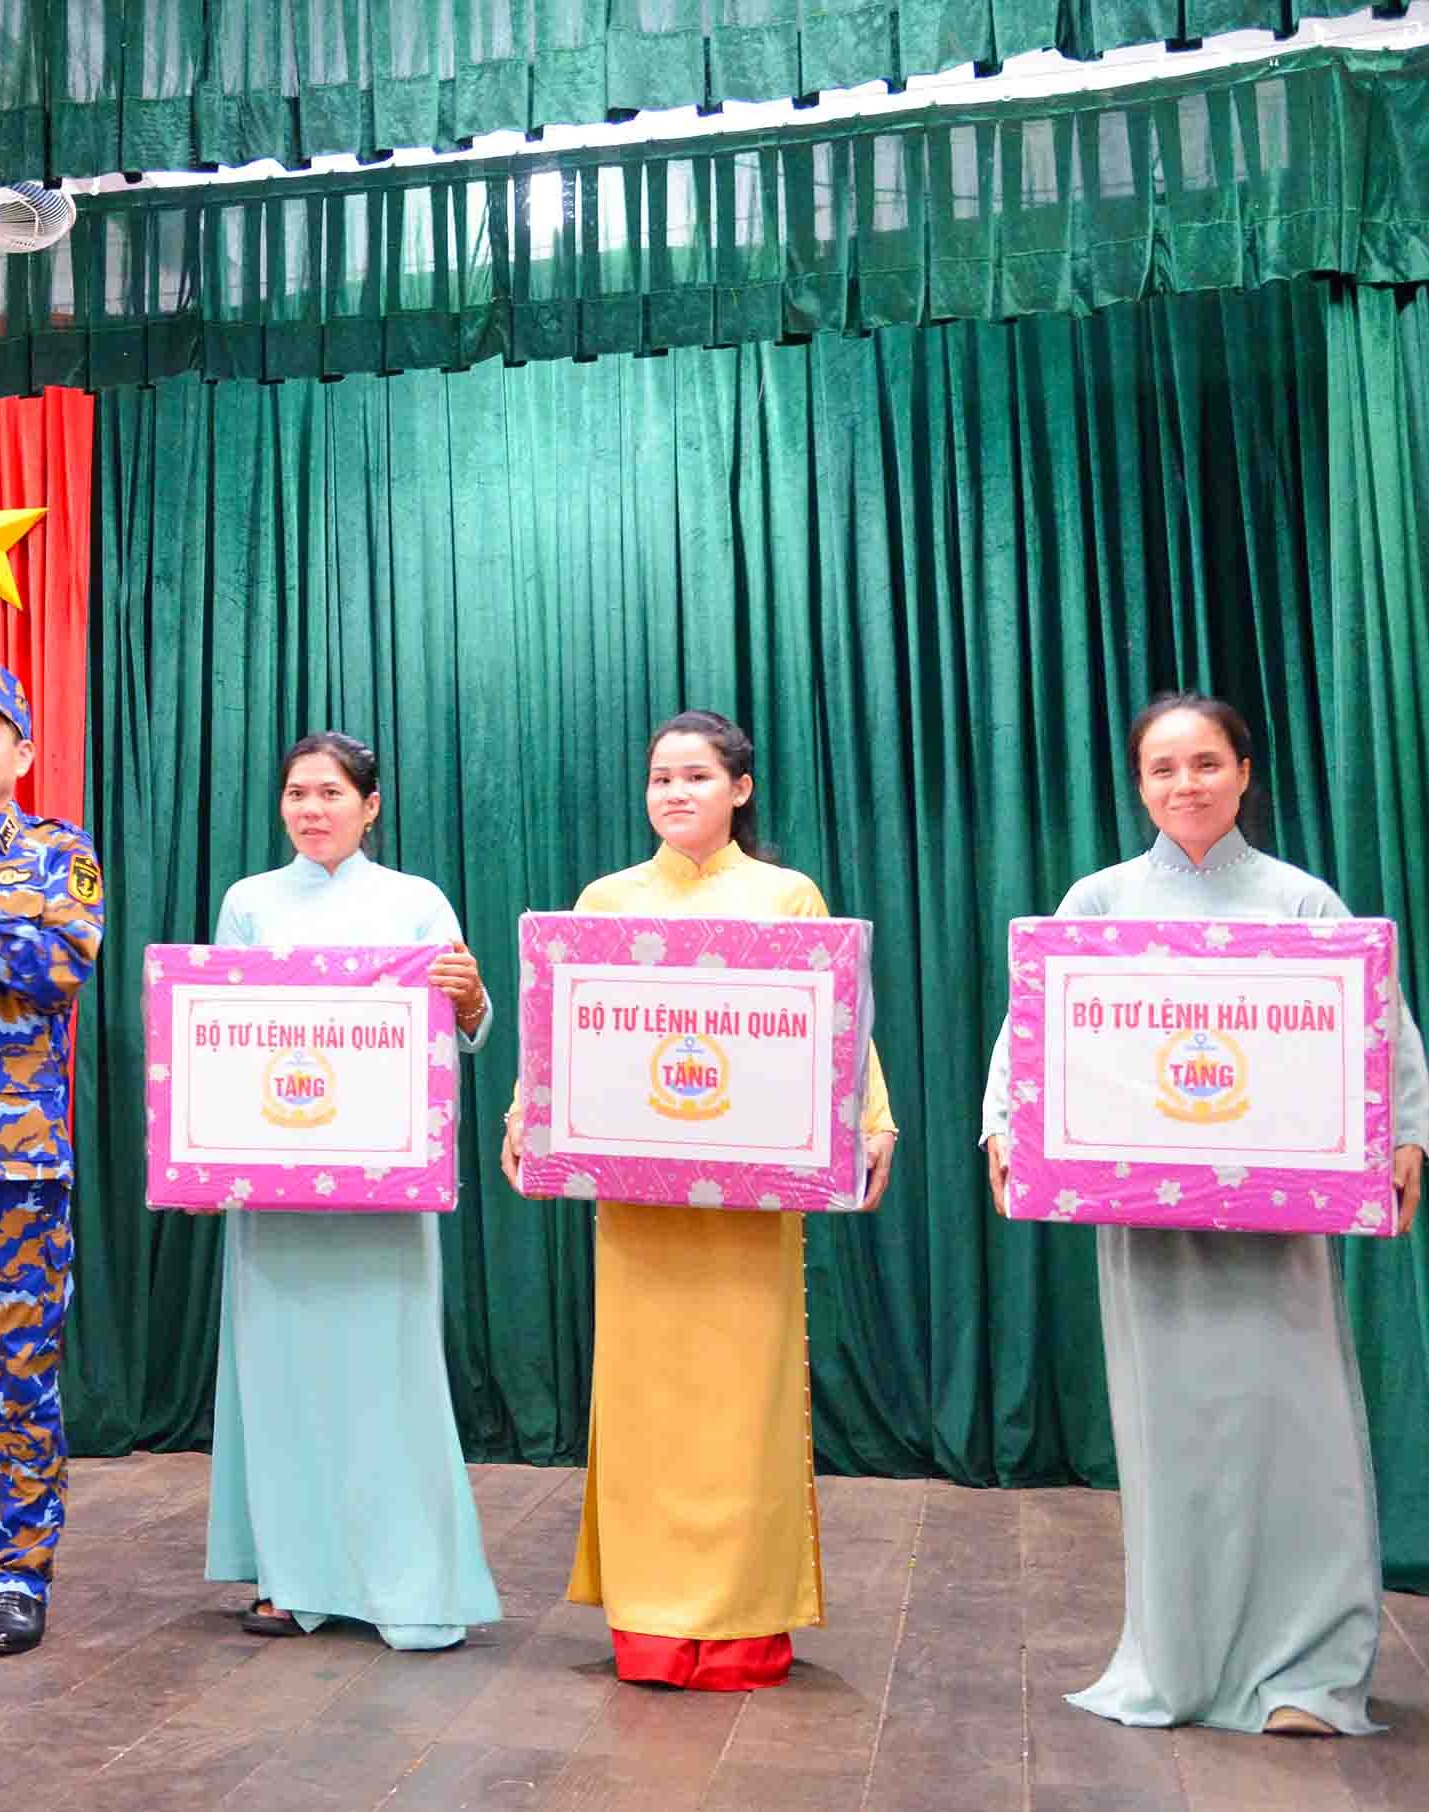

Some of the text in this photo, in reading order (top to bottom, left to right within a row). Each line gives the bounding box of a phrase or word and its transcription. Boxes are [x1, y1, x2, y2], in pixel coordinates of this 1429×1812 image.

[578, 1001, 807, 1038] BỘ TƯ LỆNH HẢI QUÂN
[1072, 996, 1335, 1034] BỘ TƯ LỆNH HẢI QUÂN
[196, 1017, 404, 1052] BỘ TƯ LỆNH HẢI QUÂN
[275, 1074, 325, 1101] TẶNG
[662, 1061, 718, 1092] TẶNG
[1169, 1060, 1235, 1091] TẶNG
